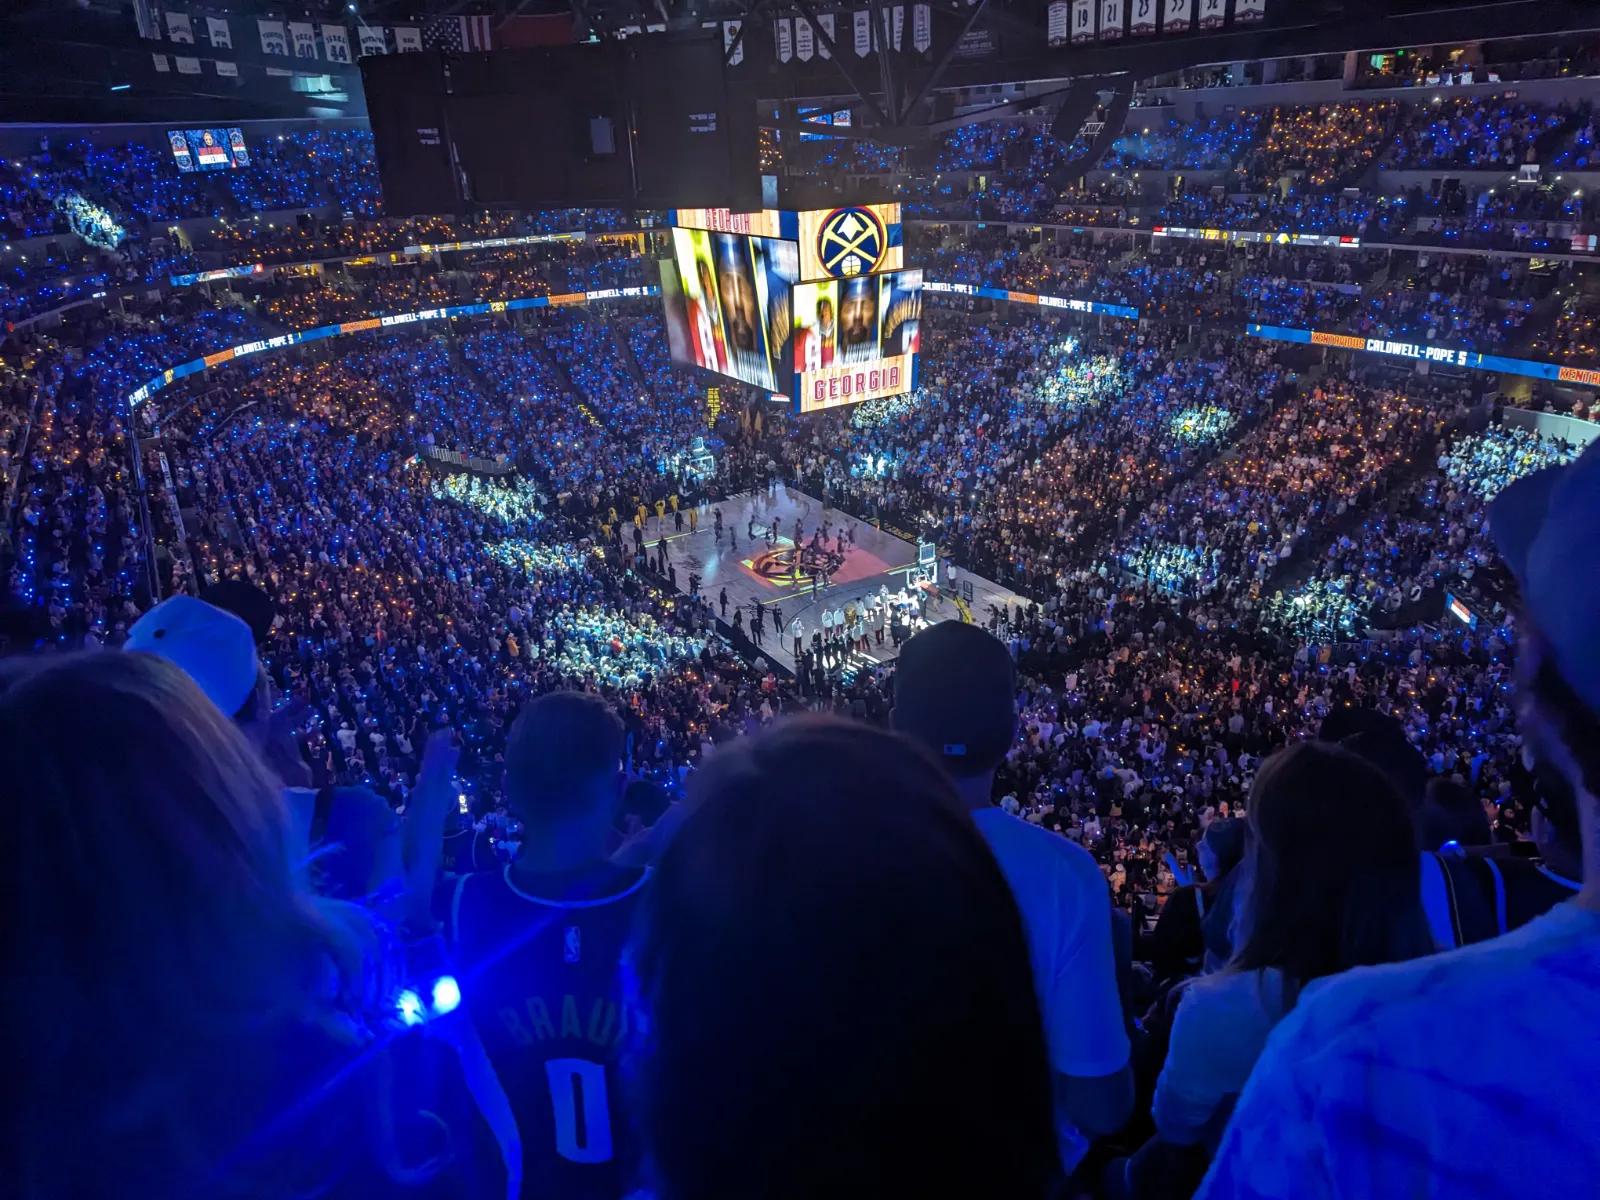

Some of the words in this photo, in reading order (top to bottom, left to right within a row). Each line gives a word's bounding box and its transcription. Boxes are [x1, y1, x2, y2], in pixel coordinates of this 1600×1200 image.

[1077, 9, 1089, 28] 19
[1107, 4, 1117, 22] 21
[705, 208, 751, 234] GEORGIA
[586, 286, 640, 300] CALDWELL-POPE
[1038, 295, 1086, 312] CALDWELL-POPE
[381, 309, 439, 326] CALDWELL-POPE
[234, 336, 287, 357] CALDWELL-POPE
[1366, 338, 1454, 363] CALDWELL-POPE
[1457, 351, 1468, 366] 5
[813, 366, 900, 402] GEORGIA
[544, 1057, 614, 1164] 0
